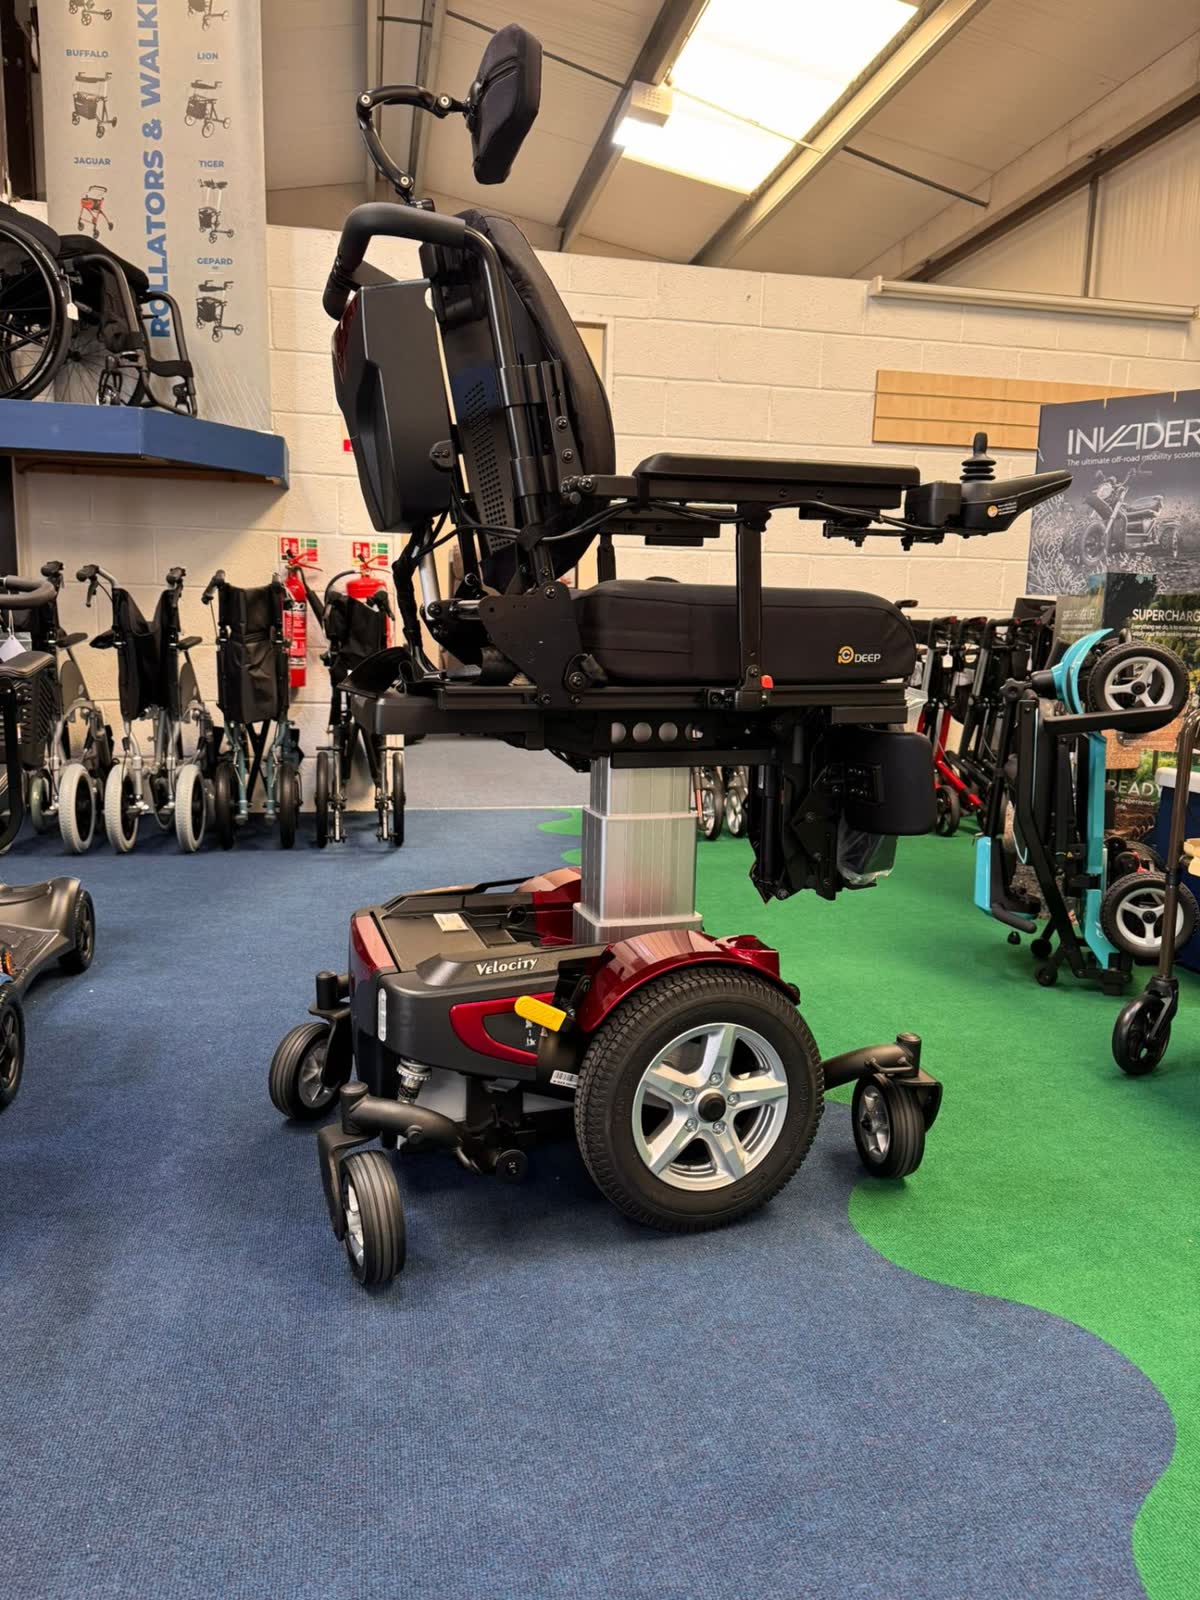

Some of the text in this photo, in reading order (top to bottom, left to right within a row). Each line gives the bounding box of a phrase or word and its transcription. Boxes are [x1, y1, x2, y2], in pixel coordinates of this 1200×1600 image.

[66, 49, 109, 59] BUFFALO
[197, 52, 219, 61] LION
[142, 118, 164, 140] &
[73, 157, 111, 166] JAGUAR
[199, 160, 225, 168] TIGER
[143, 150, 170, 338] ROLLATORS
[197, 257, 233, 265] GEPARD
[1067, 418, 1200, 456] INVADER
[1067, 458, 1080, 467] The
[1081, 457, 1110, 466] ultimate
[1111, 454, 1140, 464] off-road
[854, 653, 881, 663] DEEP
[1107, 778, 1163, 798] READY
[476, 957, 537, 976] Velocity
